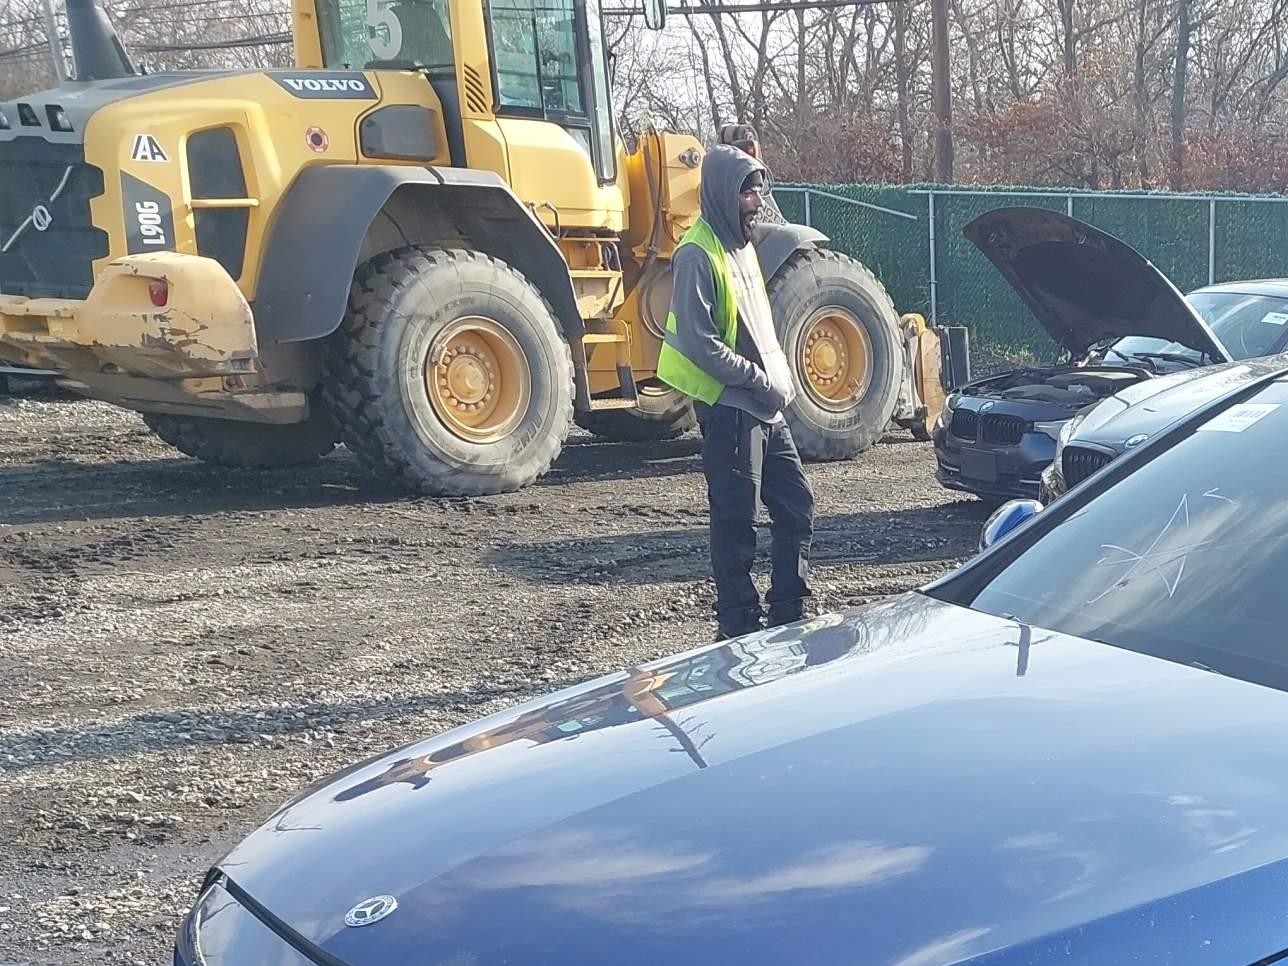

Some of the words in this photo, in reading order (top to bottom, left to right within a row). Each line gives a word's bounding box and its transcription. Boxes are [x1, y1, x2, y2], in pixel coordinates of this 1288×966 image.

[366, 0, 402, 60] 5
[283, 78, 365, 92] VOLVO
[135, 200, 166, 245] L90G
